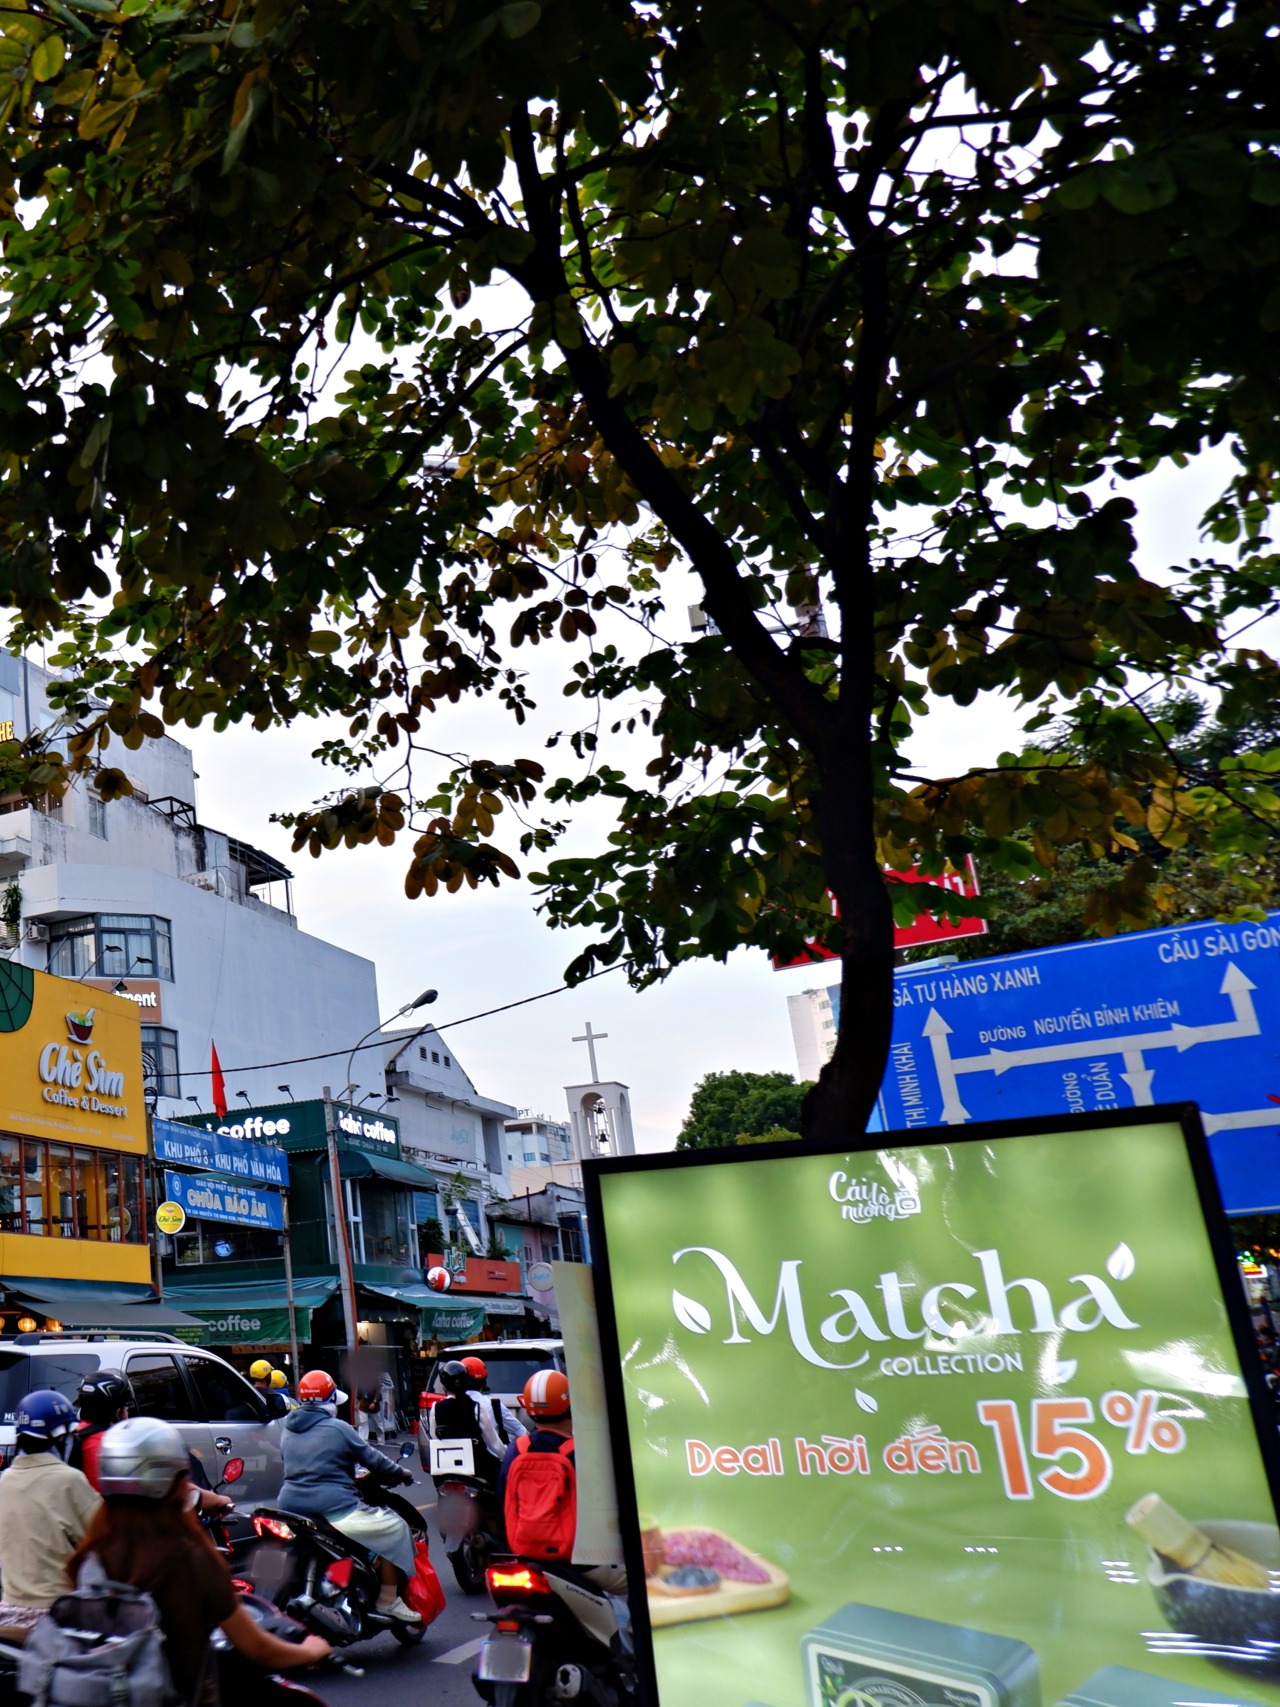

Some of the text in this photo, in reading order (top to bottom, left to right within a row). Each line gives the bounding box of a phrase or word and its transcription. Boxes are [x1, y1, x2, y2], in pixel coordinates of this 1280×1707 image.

[1158, 933, 1200, 963] CẦU
[1204, 928, 1240, 957] SÀI
[914, 979, 937, 1003] TƯ
[939, 974, 988, 1000] HÀNG
[993, 965, 1041, 992] XANH
[979, 997, 1181, 1044] ĐƯỜNG NGUYỄN BỈNH KHIÊM
[39, 1042, 124, 1098] Chè Sim
[890, 1042, 929, 1129] THỊ MINH KHAI
[42, 1087, 128, 1117] Coffee & Dessert
[216, 1117, 291, 1139] coffee
[363, 1120, 396, 1144] coffee
[163, 1140, 282, 1182] KHU PHỐ 8 KHU PHỐ VĂN HÓA
[187, 1188, 223, 1212] CHÙA
[251, 1197, 268, 1219] ÂN
[829, 1171, 872, 1203] Cái
[871, 1182, 890, 1206] lò
[208, 1315, 261, 1332] coffee
[431, 1312, 452, 1328] laha
[671, 1245, 1142, 1370] Matcha
[879, 1351, 1023, 1377] COLLECTION
[685, 1389, 1187, 1501] Deal hời đến 15%
